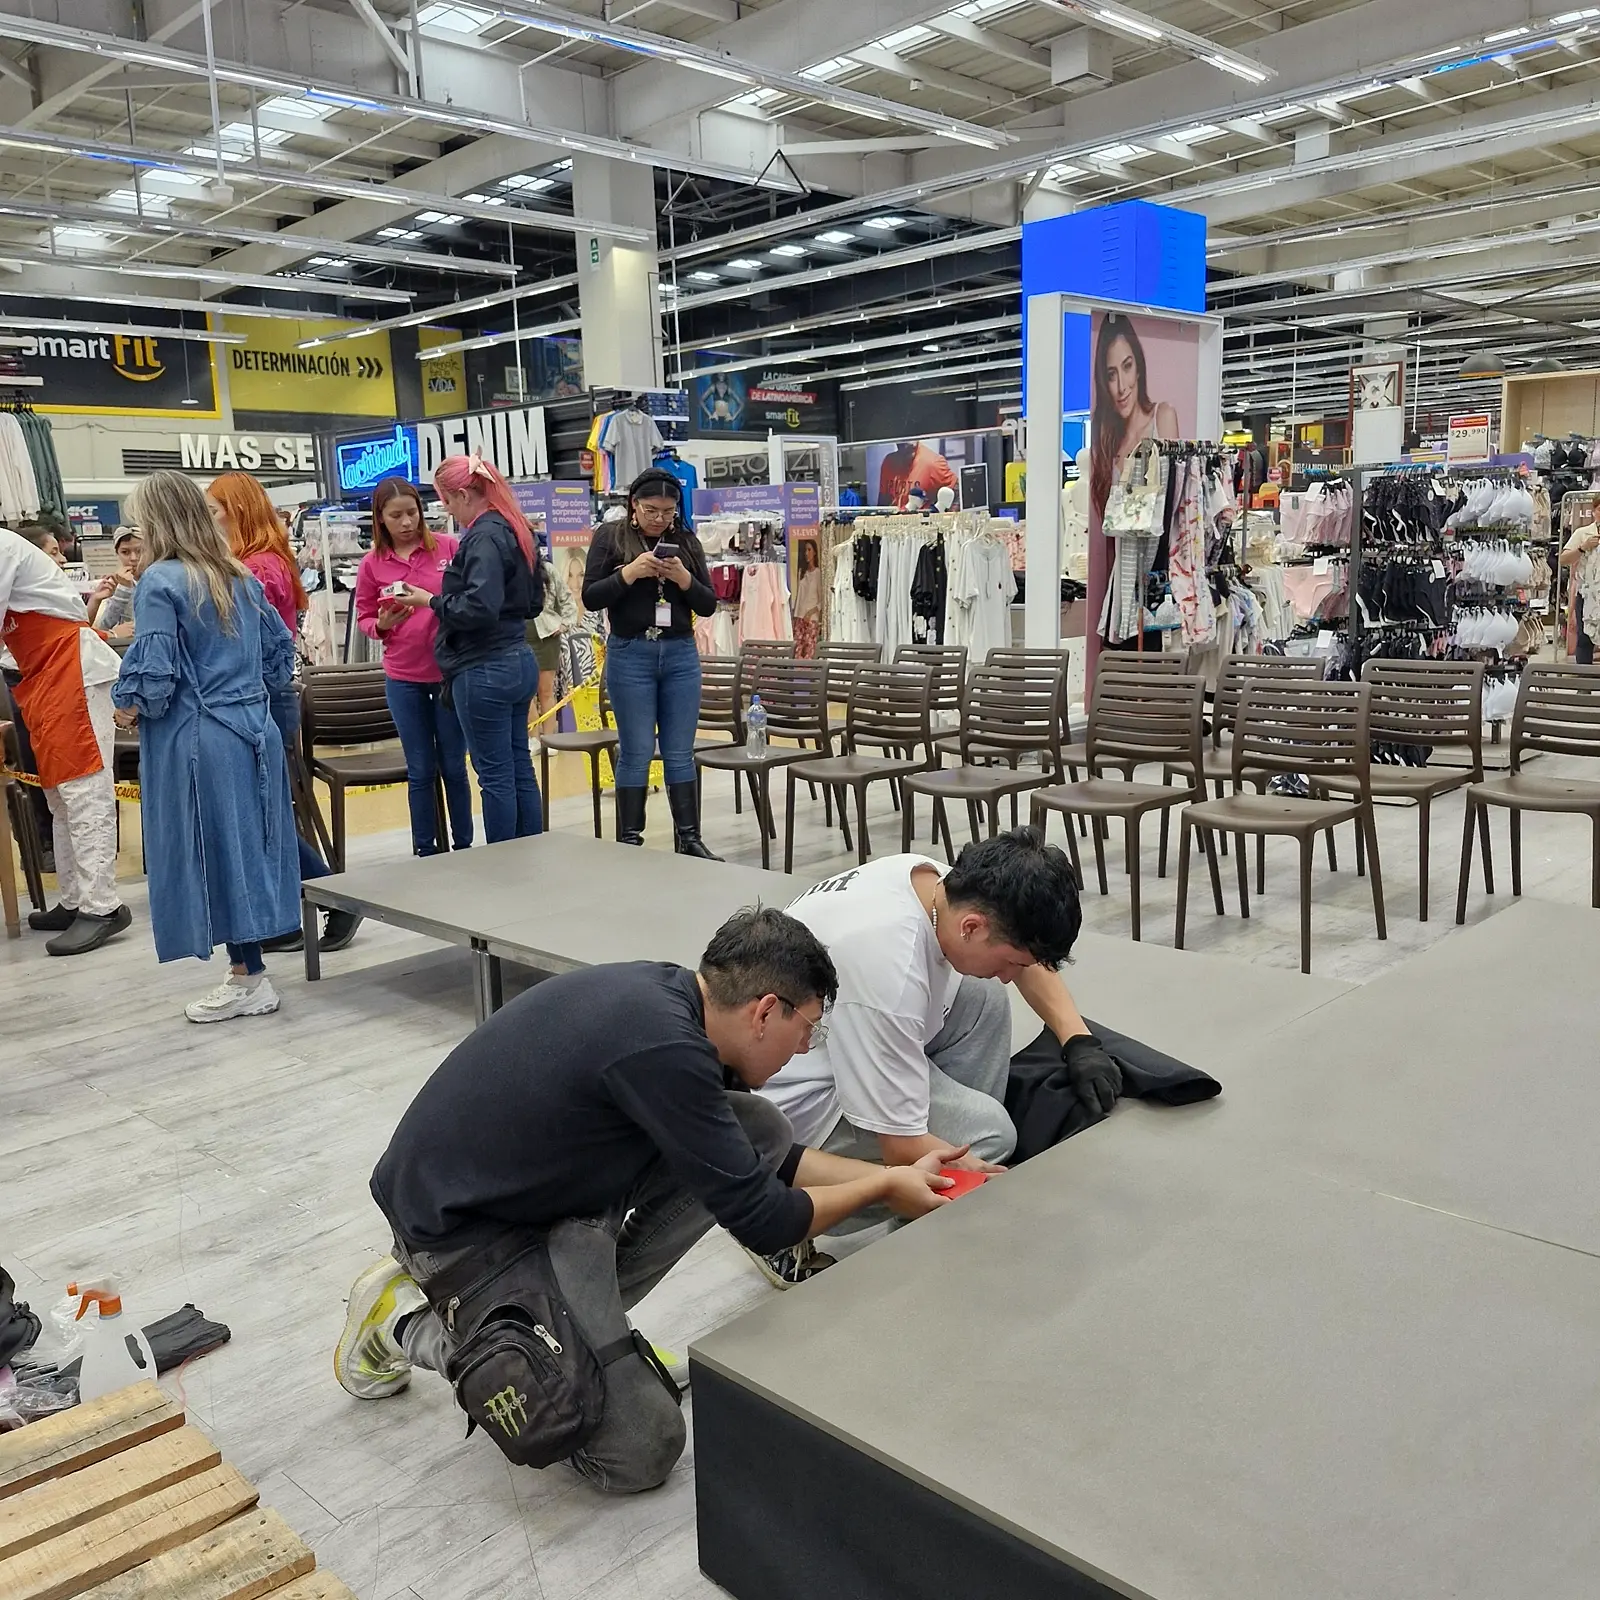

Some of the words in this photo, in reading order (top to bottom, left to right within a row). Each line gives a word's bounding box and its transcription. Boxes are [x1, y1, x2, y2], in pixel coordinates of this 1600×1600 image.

[232, 349, 350, 377] DETERMINACIÓN
[429, 378, 455, 392] VIDA
[417, 406, 549, 484] DENIM
[180, 434, 261, 470] MAS
[274, 437, 316, 471] SE
[552, 498, 569, 507] Elige
[570, 499, 589, 507] cómo
[552, 508, 590, 517] sorprender
[1579, 509, 1592, 518] LE
